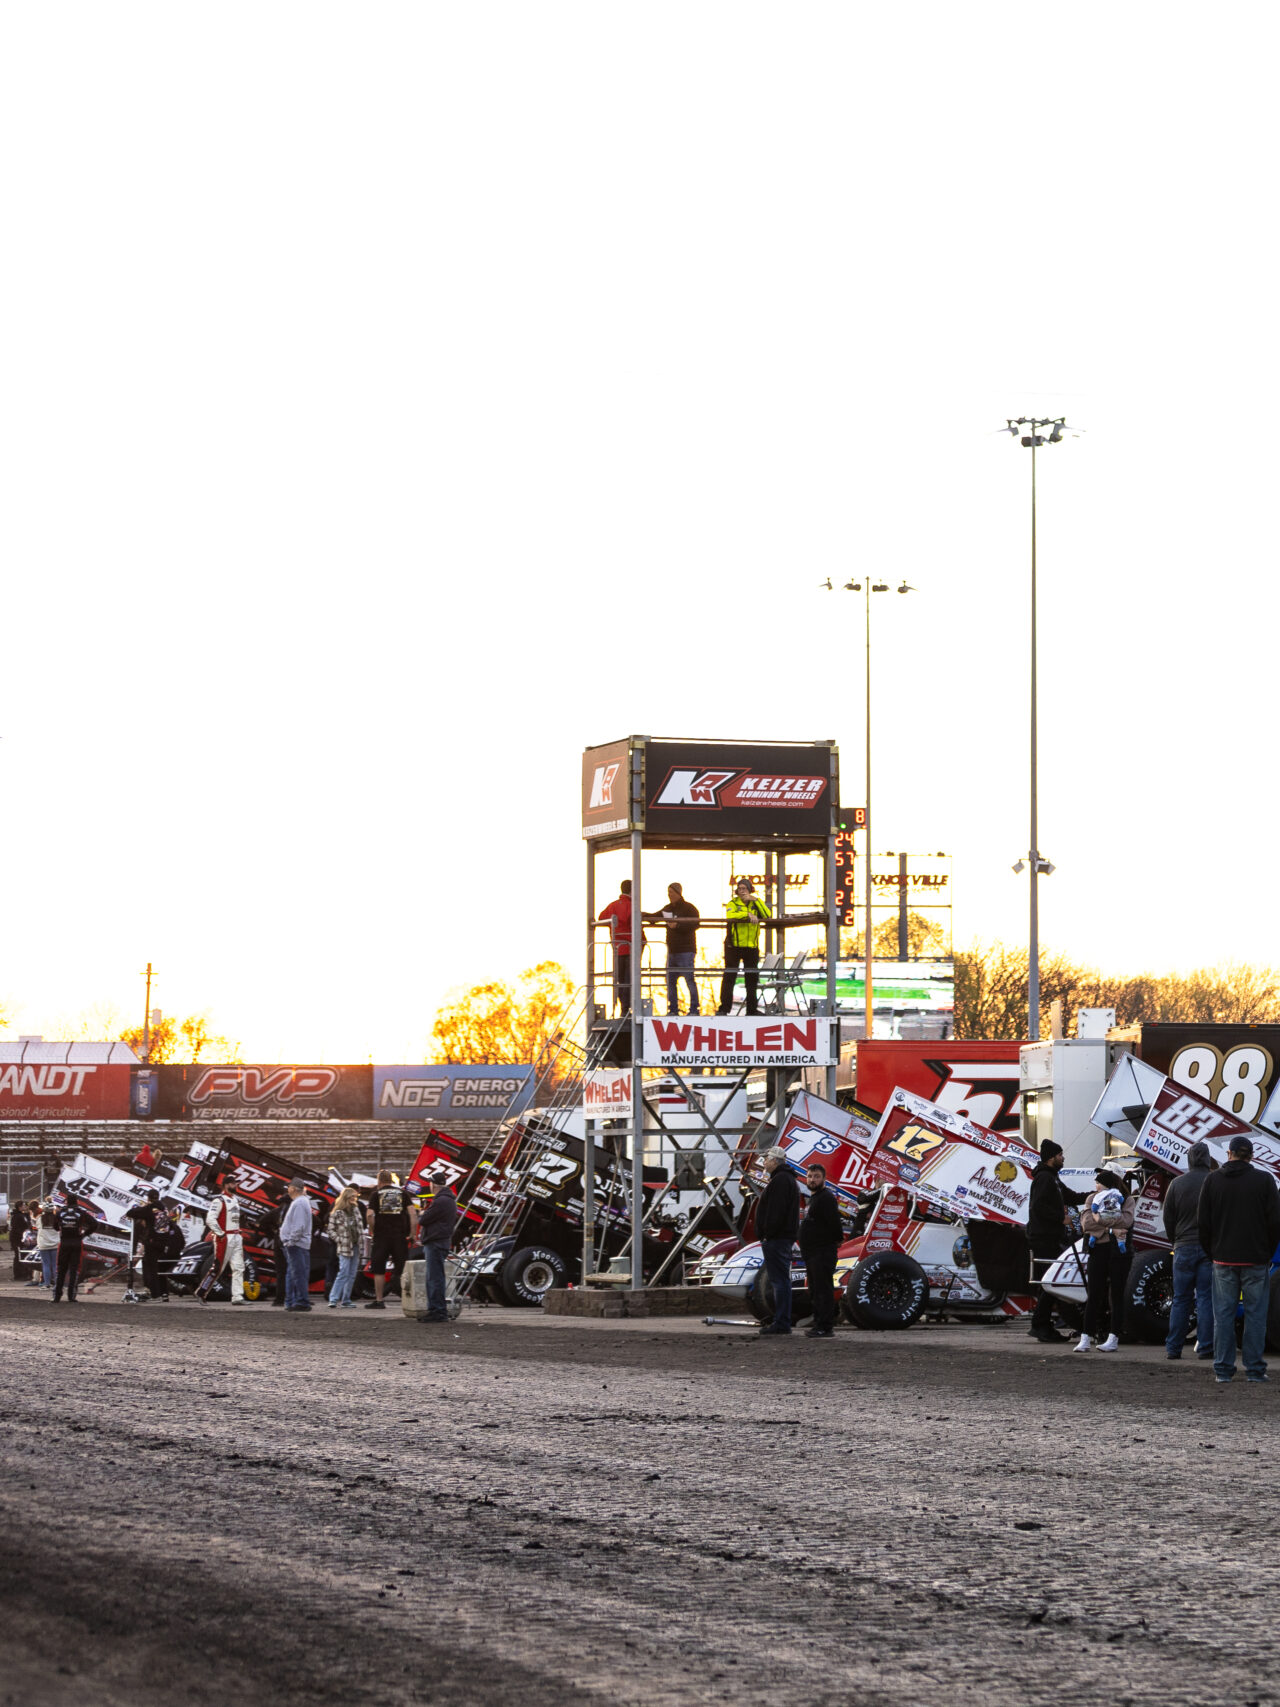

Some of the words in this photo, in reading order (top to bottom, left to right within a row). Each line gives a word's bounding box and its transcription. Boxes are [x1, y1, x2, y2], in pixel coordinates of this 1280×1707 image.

[740, 777, 824, 791] KEIZER
[736, 790, 780, 798] ALUMINUM
[784, 791, 817, 799] WHEELS
[855, 808, 865, 824] 8
[834, 832, 854, 847] 24
[834, 851, 854, 866] 57
[844, 871, 854, 886] 2
[844, 910, 854, 925] 2
[650, 1018, 817, 1052] WHELEN
[661, 1055, 750, 1065] MANUFACTURED
[753, 1055, 765, 1064] IN
[768, 1055, 817, 1064] AMERICA
[0, 1064, 96, 1096] ANDT
[188, 1064, 340, 1106] FVP
[453, 1079, 525, 1093] ENERGY
[584, 1073, 631, 1105] WHELEN
[1169, 1043, 1273, 1124] 88
[380, 1077, 449, 1108] NOS
[452, 1093, 508, 1108] DRINK
[192, 1107, 261, 1119] VERIFIED.
[266, 1107, 330, 1119] PROVEN.
[1156, 1094, 1225, 1144] 83
[887, 1124, 946, 1162] 17
[971, 1136, 999, 1152] SUPPLY
[1144, 1138, 1171, 1162] Mobil
[1170, 1151, 1181, 1164] 1
[233, 1163, 272, 1192] 55
[419, 1157, 468, 1187] 55
[530, 1152, 579, 1186] 27
[67, 1177, 100, 1197] 45
[984, 1190, 1004, 1204] PURE
[968, 1189, 992, 1205] MAPLE
[992, 1200, 1017, 1216] SYRUP
